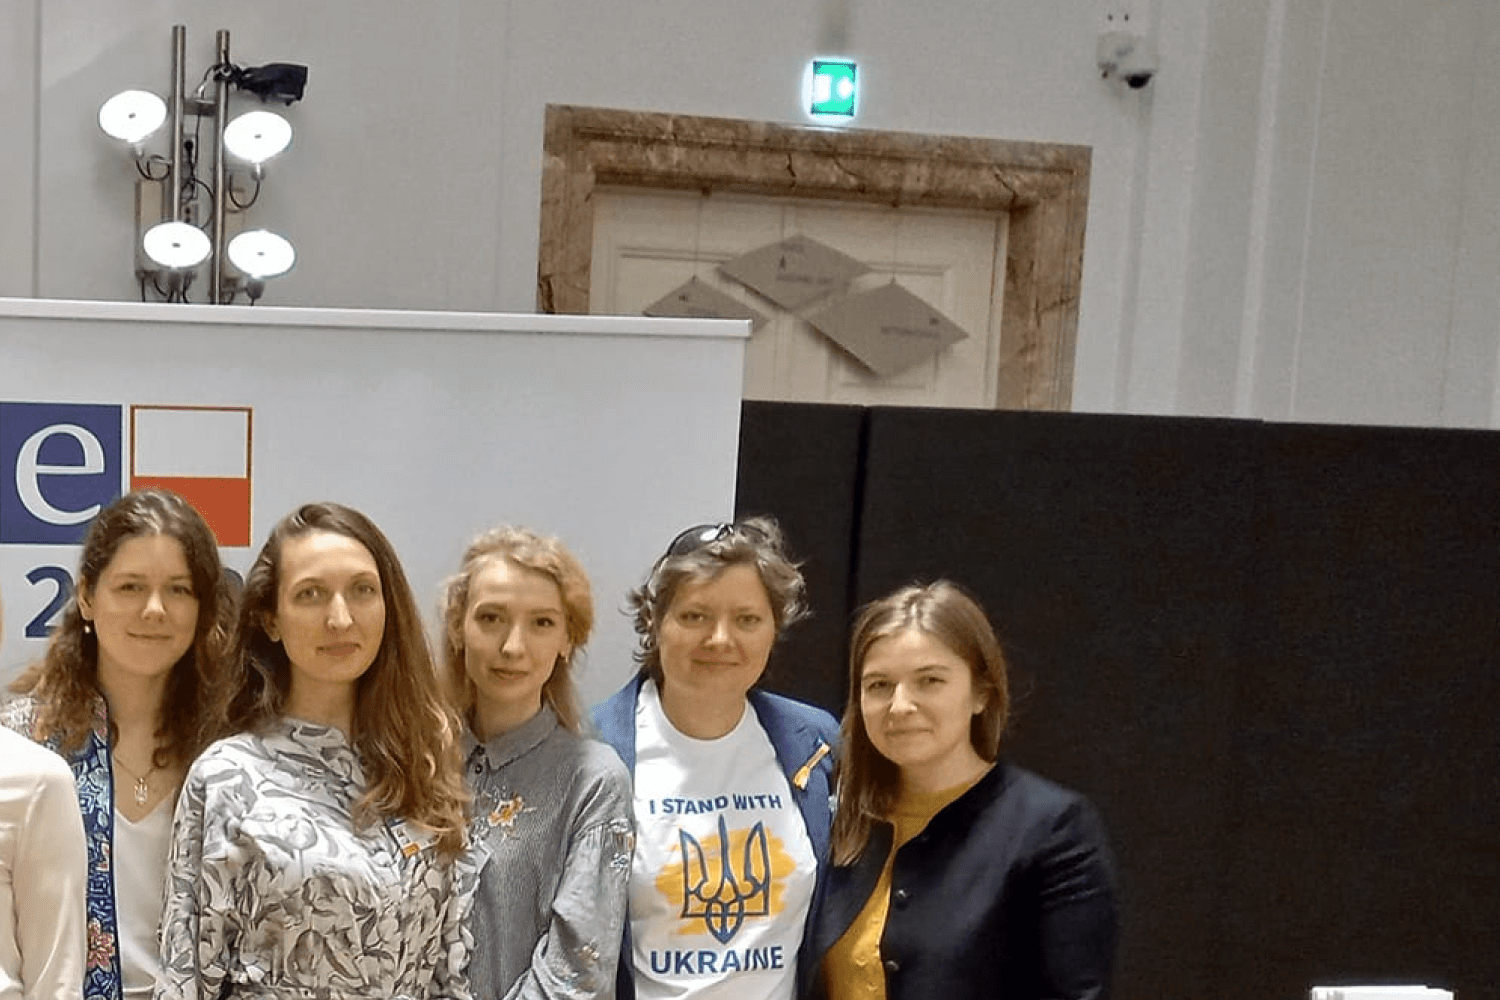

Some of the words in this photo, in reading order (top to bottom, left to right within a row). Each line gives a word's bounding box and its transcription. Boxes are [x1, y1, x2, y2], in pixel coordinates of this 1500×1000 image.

[649, 800, 656, 814] I
[663, 796, 728, 814] STAND
[732, 793, 783, 810] WITH
[651, 946, 784, 975] UKRAINE
